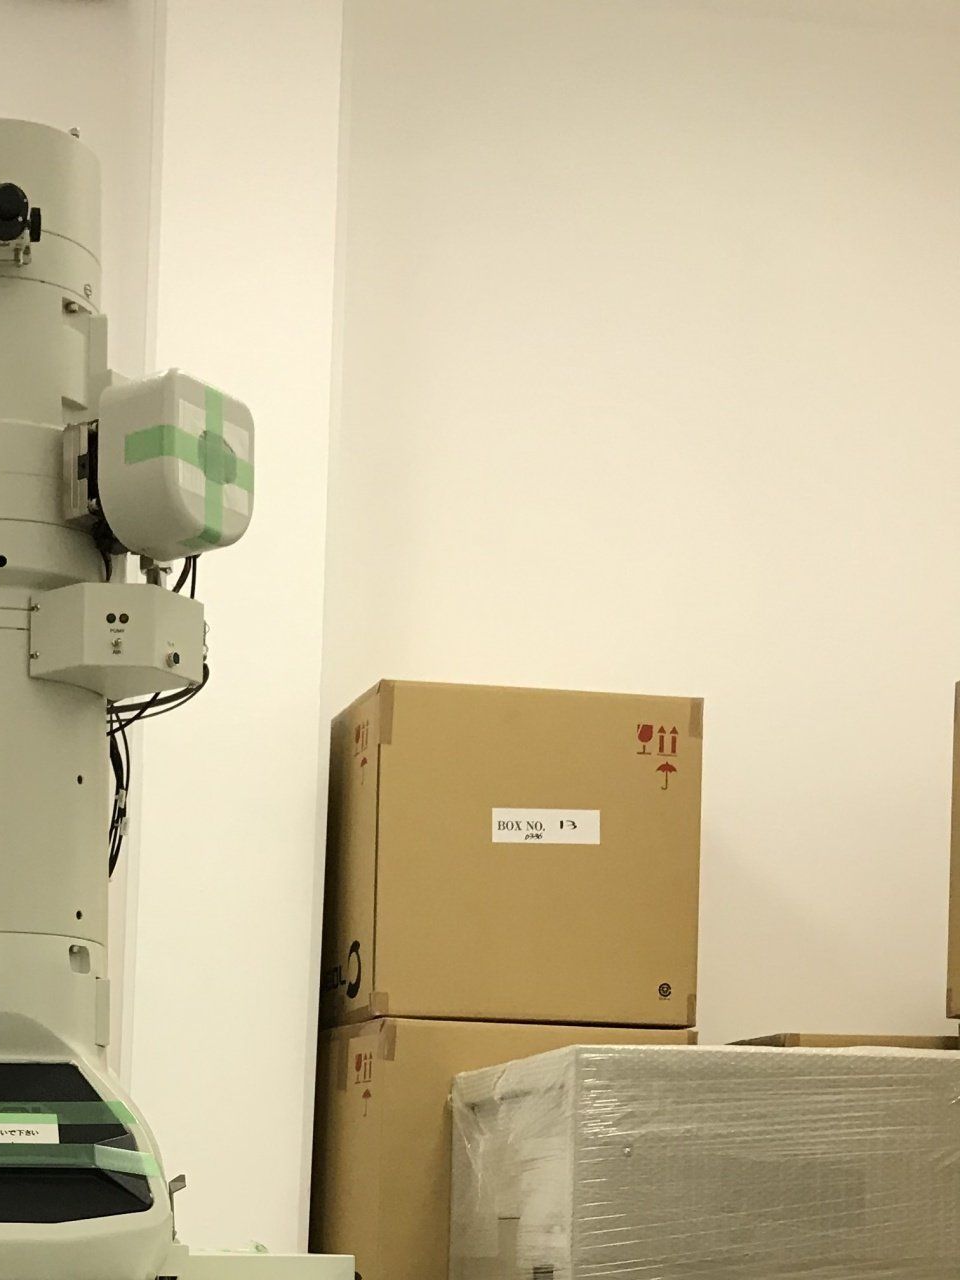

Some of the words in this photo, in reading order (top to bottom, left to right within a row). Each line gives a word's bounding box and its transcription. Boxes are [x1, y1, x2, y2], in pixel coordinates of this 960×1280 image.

[497, 820, 522, 831] BOX
[526, 820, 546, 831] NO.
[559, 820, 578, 830] 13
